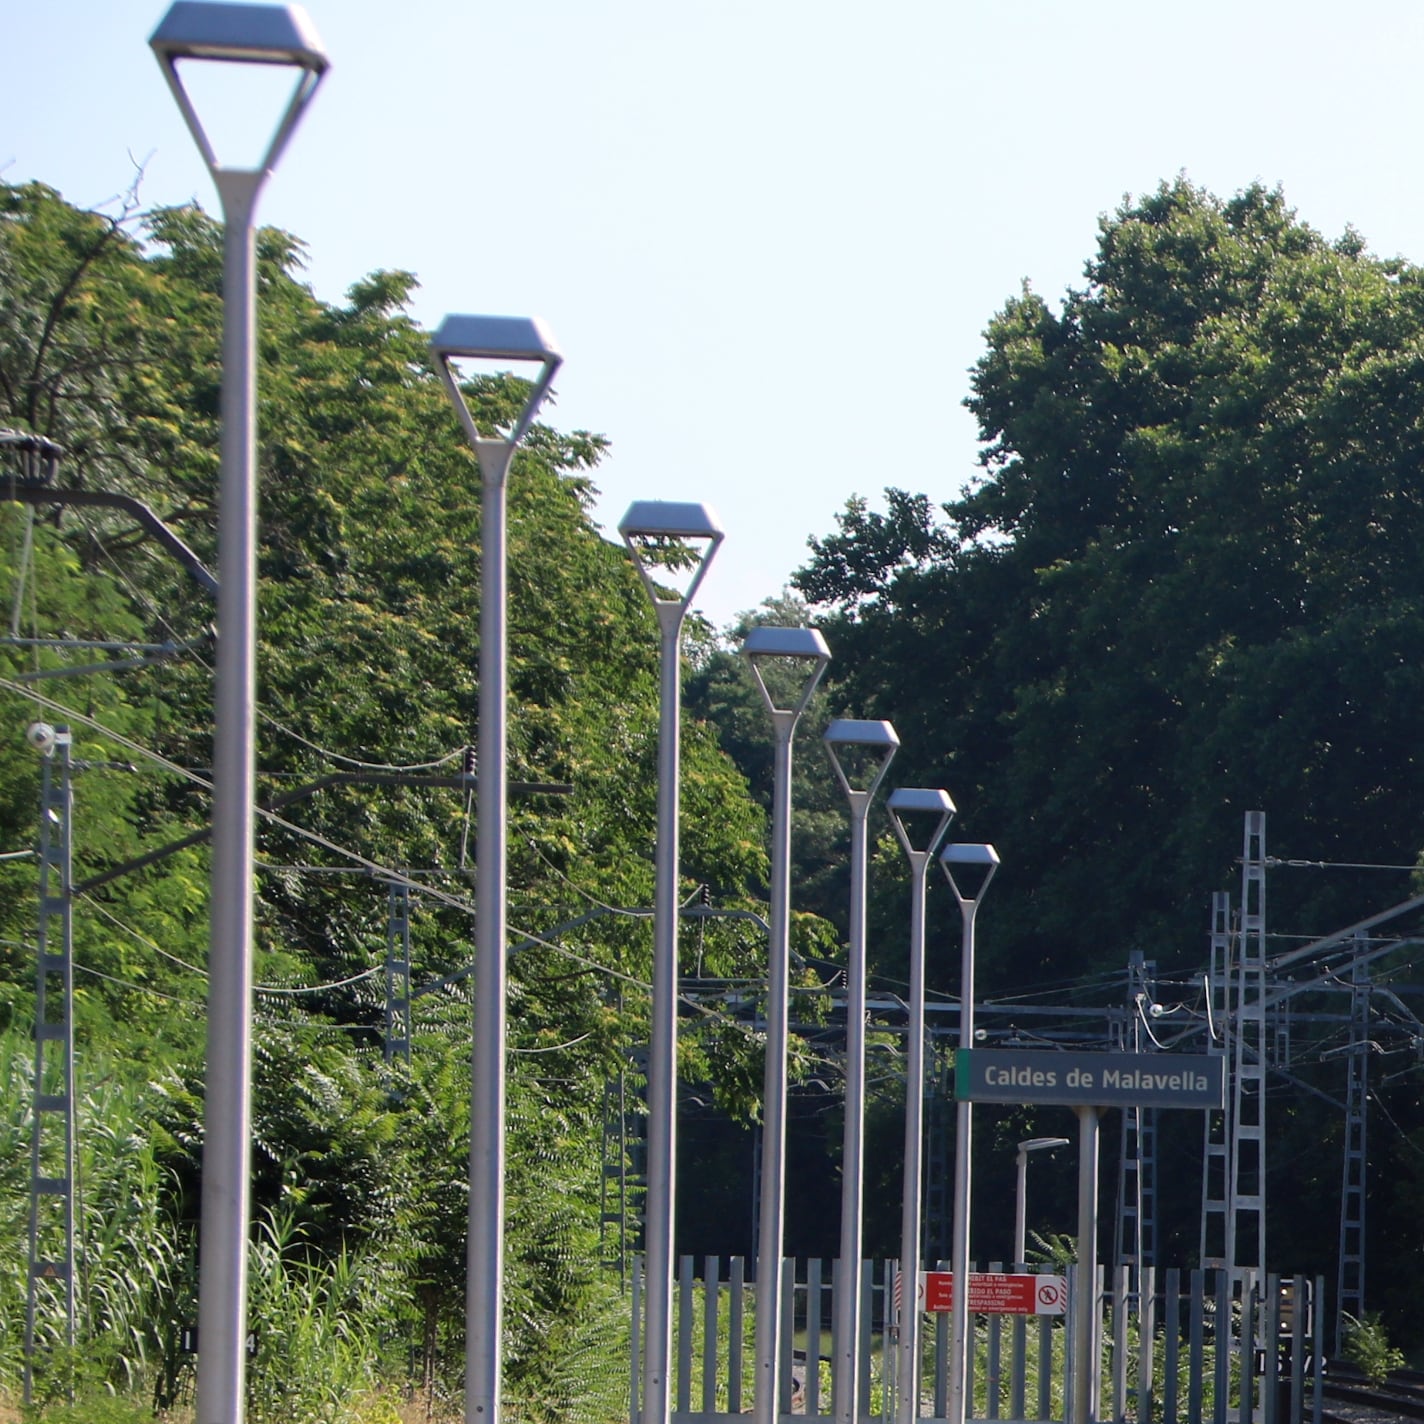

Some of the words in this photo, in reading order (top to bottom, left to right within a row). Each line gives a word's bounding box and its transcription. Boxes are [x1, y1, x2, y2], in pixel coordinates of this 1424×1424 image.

[985, 1065, 1057, 1088] Caldes
[1066, 1067, 1093, 1089] de
[1102, 1069, 1208, 1092] Malavella
